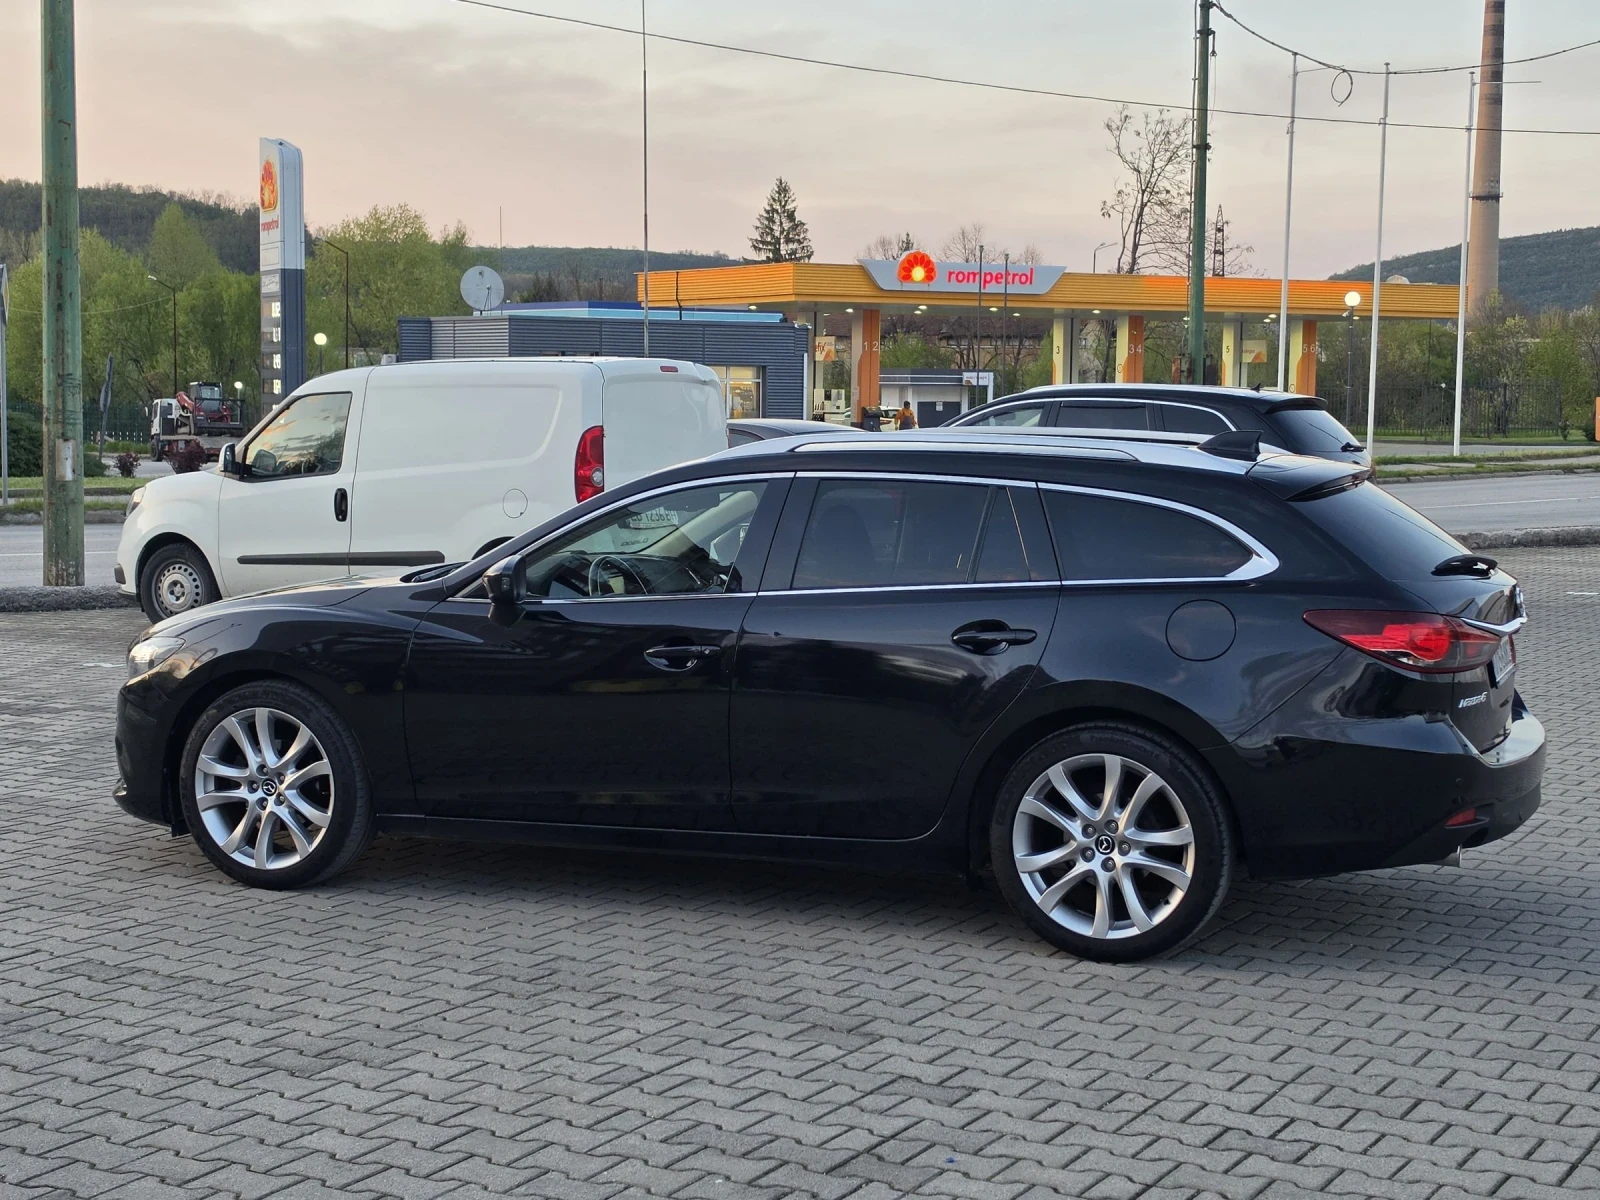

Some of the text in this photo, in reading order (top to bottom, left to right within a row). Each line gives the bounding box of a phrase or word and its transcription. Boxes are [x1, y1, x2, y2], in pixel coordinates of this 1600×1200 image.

[947, 267, 1034, 290] rompetrol
[872, 341, 879, 351] 2
[1056, 345, 1060, 355] 3
[1129, 344, 1142, 354] 3 4
